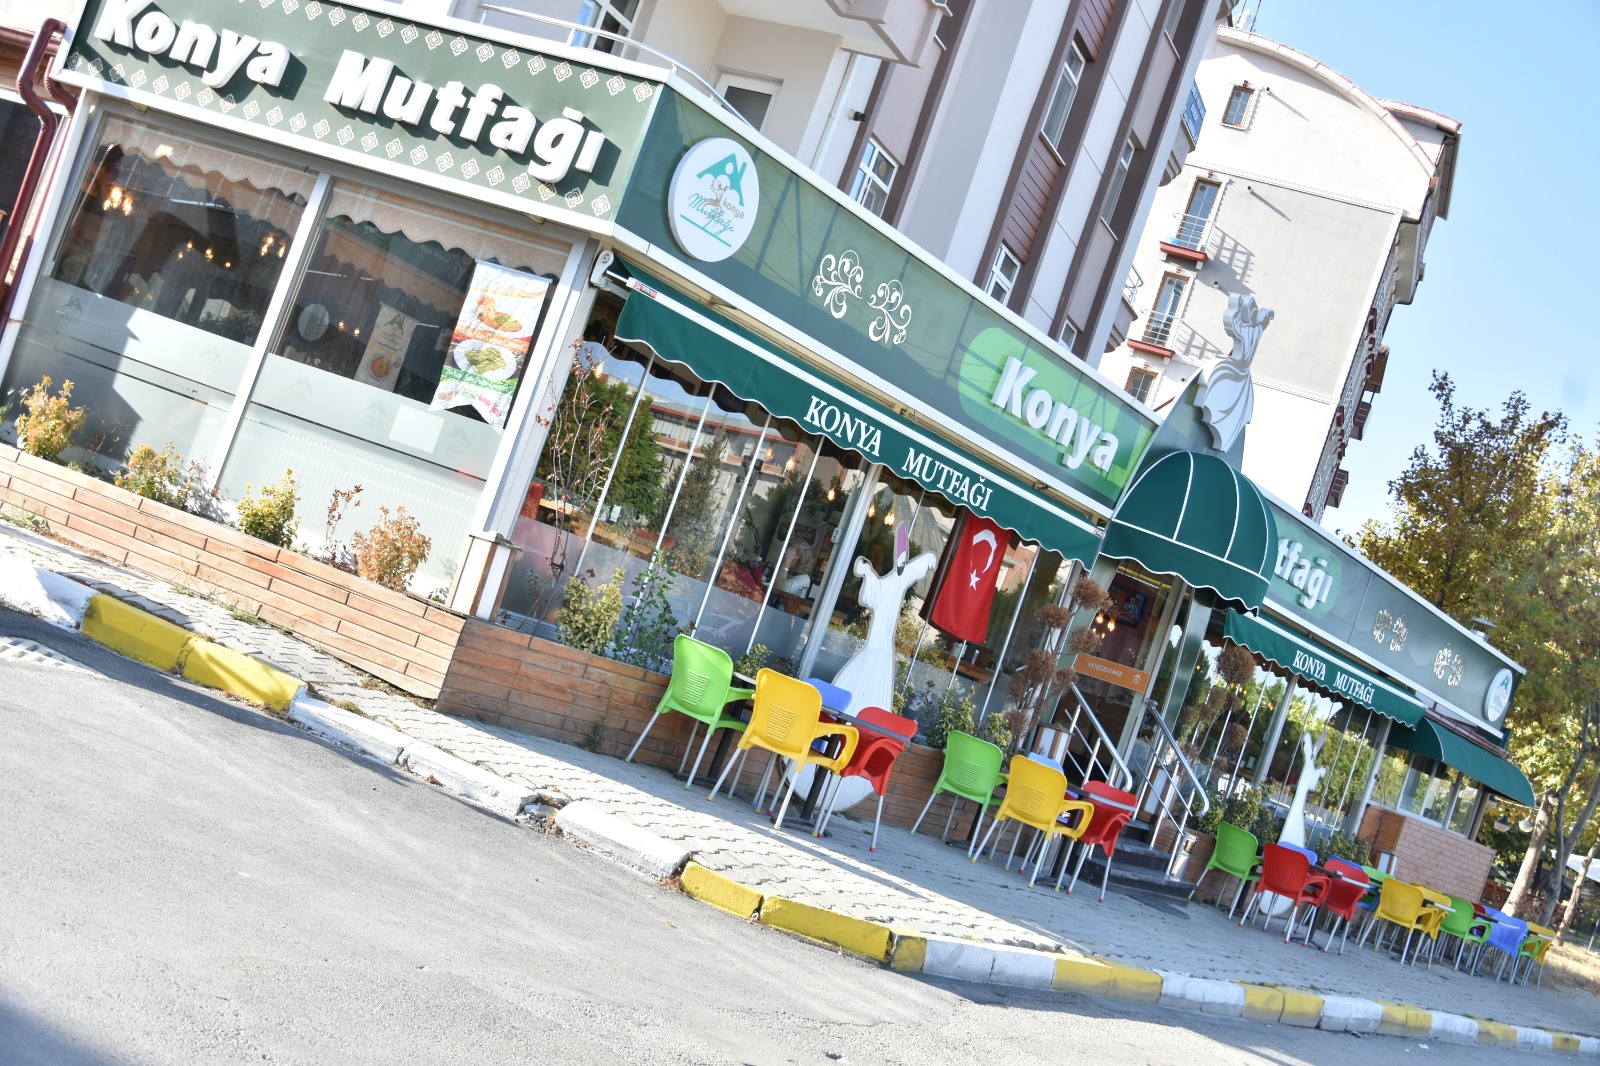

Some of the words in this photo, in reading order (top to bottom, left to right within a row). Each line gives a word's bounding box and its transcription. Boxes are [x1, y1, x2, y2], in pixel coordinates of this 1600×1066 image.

[93, 0, 290, 89] Konya
[322, 49, 607, 184] Mutfağı
[722, 199, 745, 220] konya
[803, 395, 883, 457] KONYA
[901, 447, 994, 511] MUTFAĞI
[990, 356, 1119, 473] Konya
[1273, 538, 1334, 610] tfağı
[1292, 650, 1326, 681] KONYA
[1333, 671, 1376, 704] MUTFAĞI
